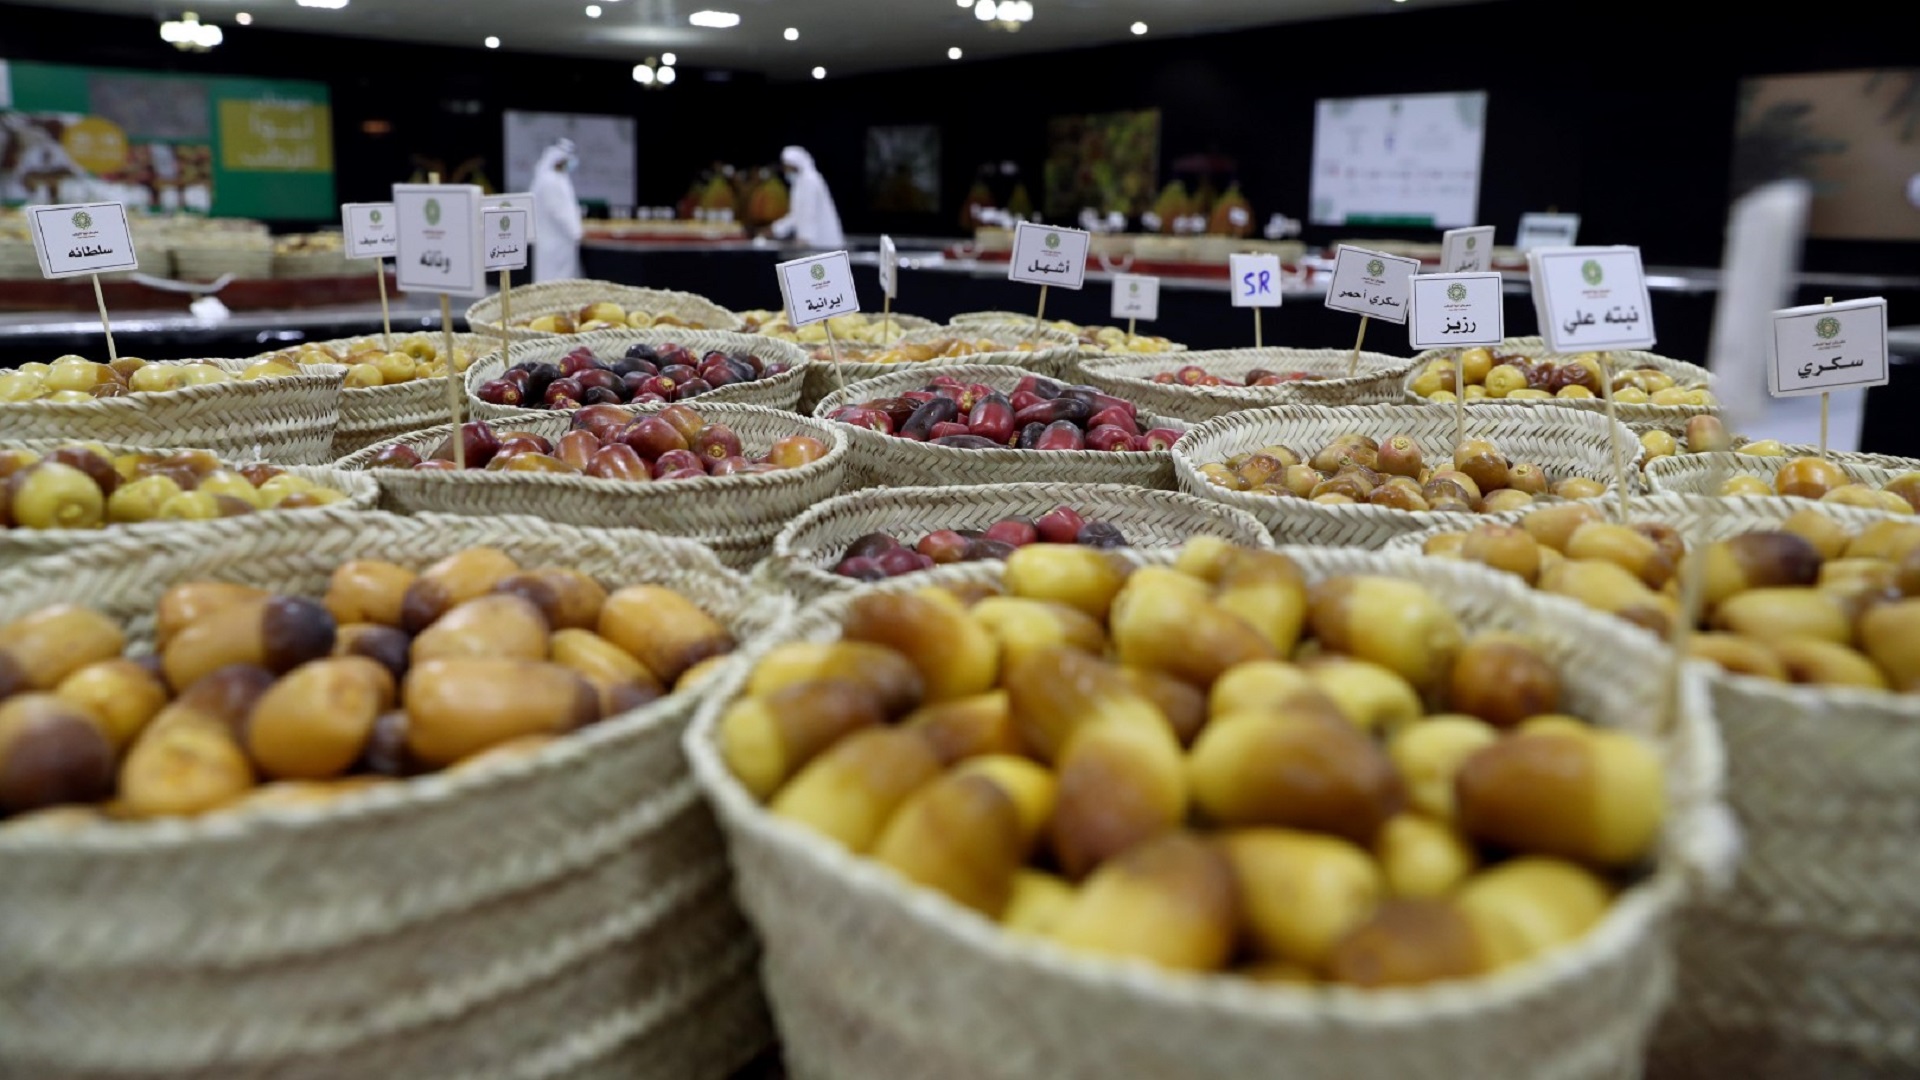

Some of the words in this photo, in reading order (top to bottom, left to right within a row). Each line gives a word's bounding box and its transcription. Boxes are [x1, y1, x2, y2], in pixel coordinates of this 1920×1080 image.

[68, 244, 113, 257] سلطانه
[489, 244, 519, 259] خنيزي
[1027, 259, 1070, 274] أشهل
[1243, 270, 1270, 296] SR
[1338, 289, 1367, 299] أحمر
[1369, 295, 1400, 307] سكري
[805, 293, 844, 312] ايرانية
[1441, 316, 1477, 334] رزيز
[1604, 305, 1639, 331] نبته
[1797, 356, 1864, 379] سكري
